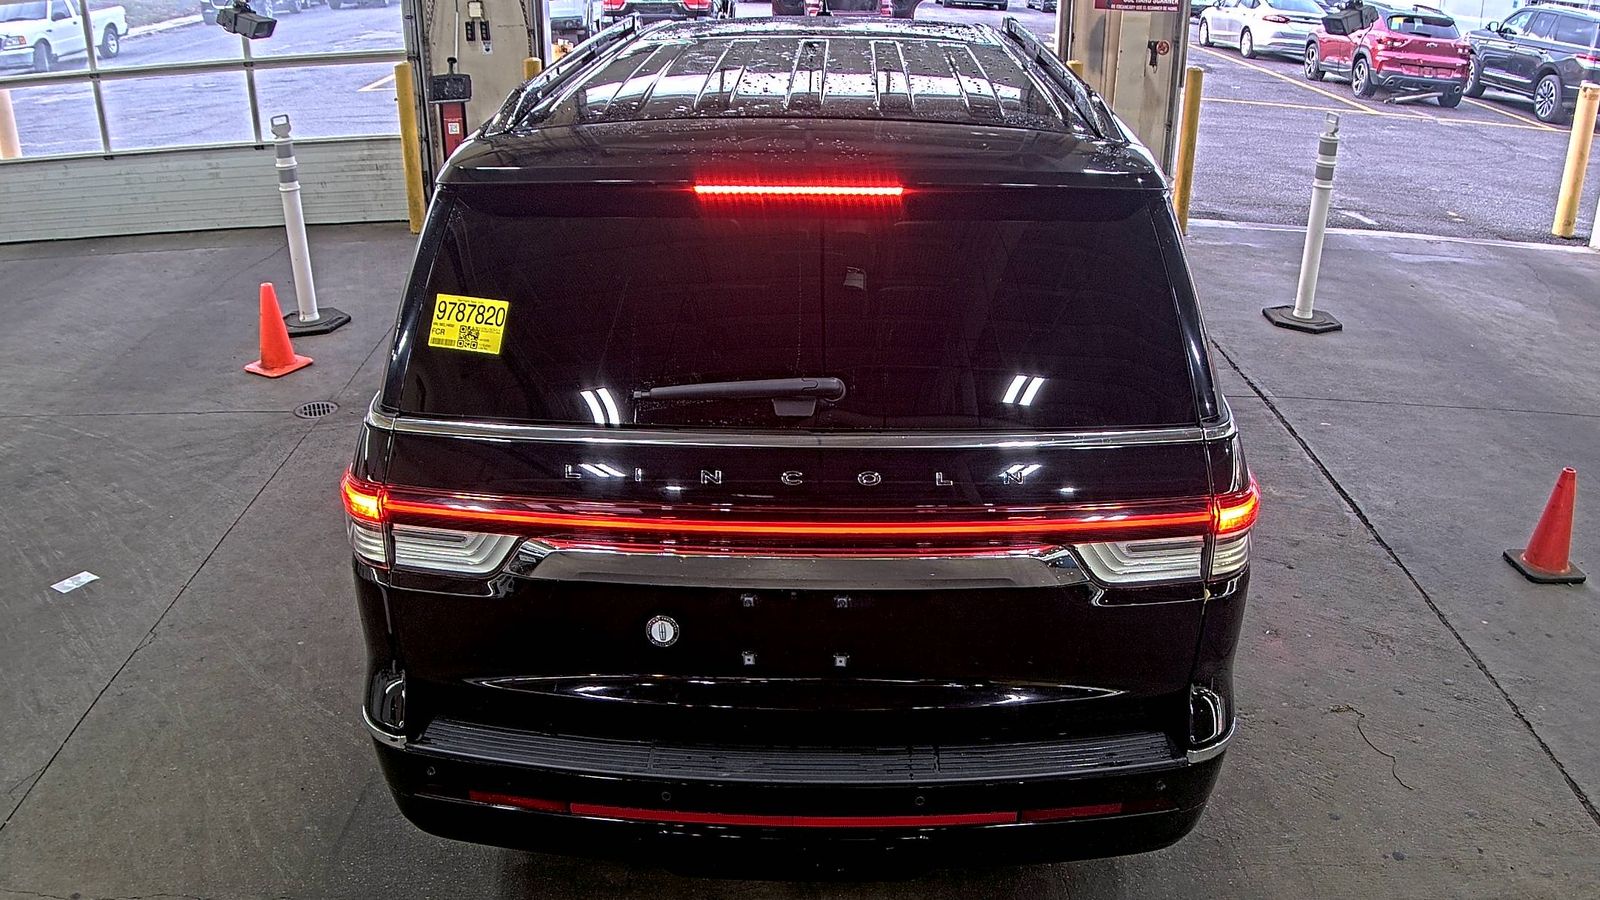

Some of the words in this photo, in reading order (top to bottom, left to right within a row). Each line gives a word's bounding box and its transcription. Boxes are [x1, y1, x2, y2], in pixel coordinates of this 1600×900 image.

[436, 300, 506, 327] 9787820
[432, 327, 446, 335] FCR
[564, 463, 1025, 486] LINCOLN
